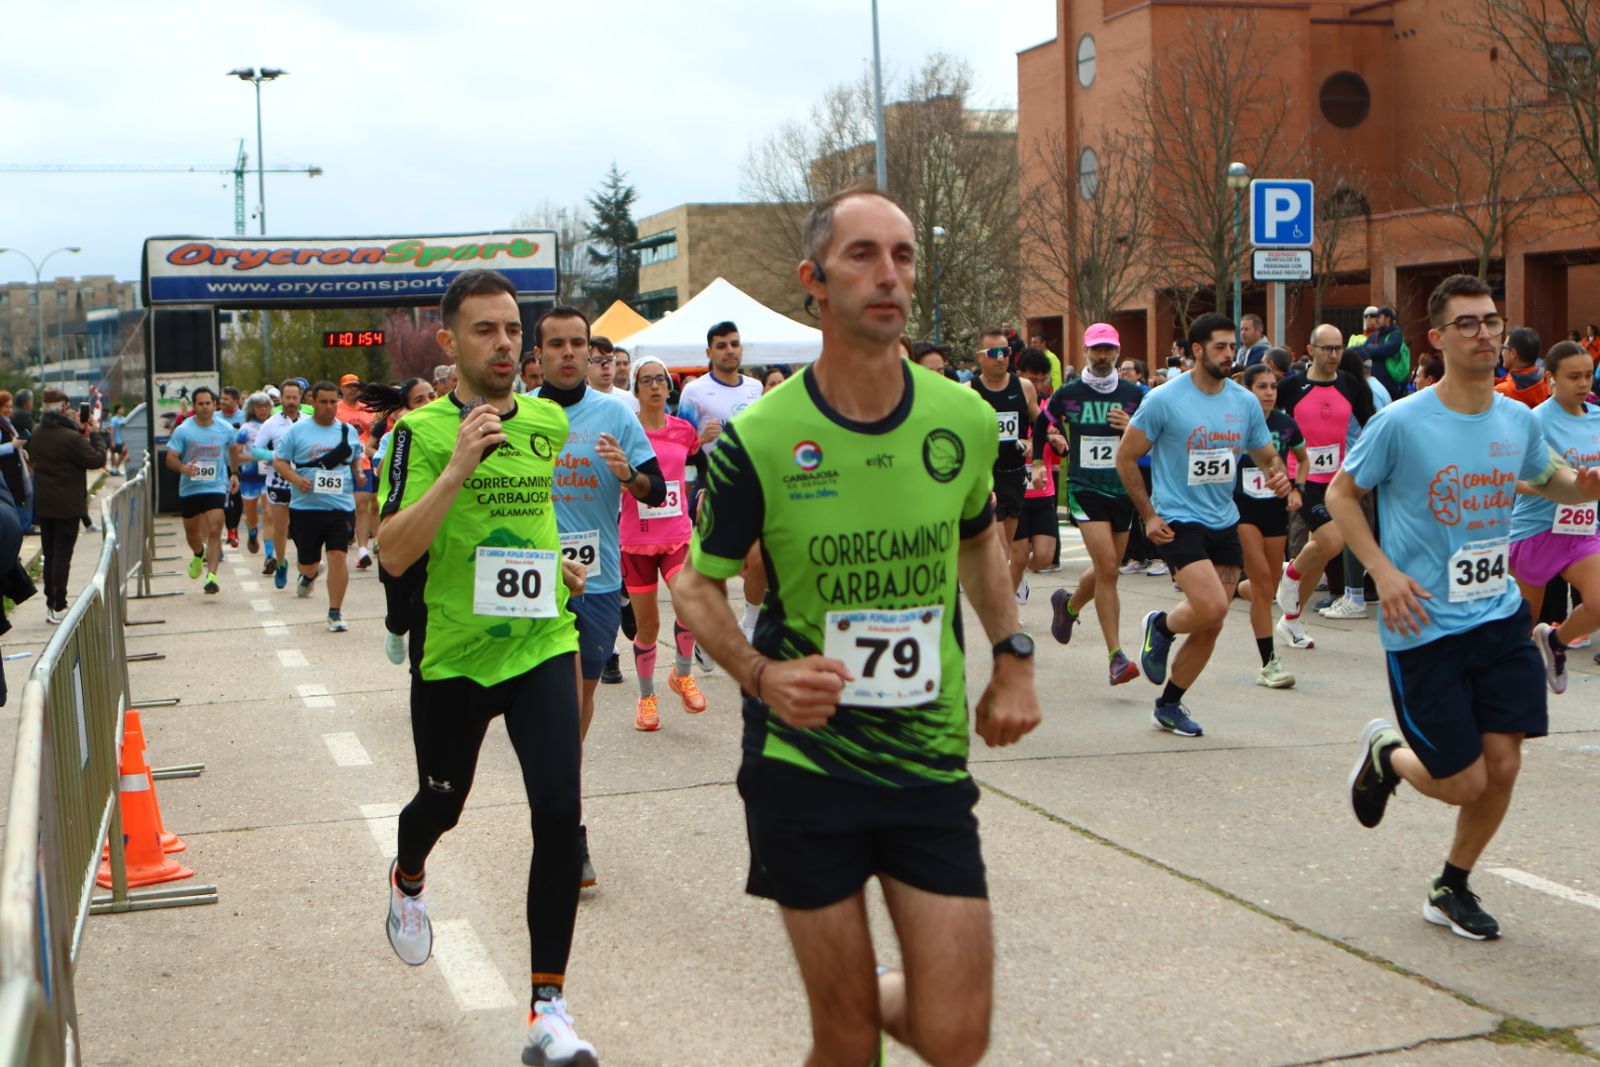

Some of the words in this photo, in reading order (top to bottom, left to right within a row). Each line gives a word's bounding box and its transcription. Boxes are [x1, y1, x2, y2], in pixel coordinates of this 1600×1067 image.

[1265, 188, 1301, 238] P
[166, 238, 539, 270] OrycronSport
[1089, 446, 1113, 460] 12
[1315, 453, 1333, 467] 41
[1193, 459, 1231, 476] 351
[317, 477, 342, 488] 363
[1463, 468, 1514, 490] contra
[477, 491, 549, 505] CARBAJOSA
[489, 507, 545, 518] SALAMANCA
[1558, 508, 1595, 526] 269
[1456, 554, 1505, 586] 384
[496, 568, 541, 599] 80
[816, 560, 947, 605] CARBAJOSA
[856, 636, 920, 679] 79
